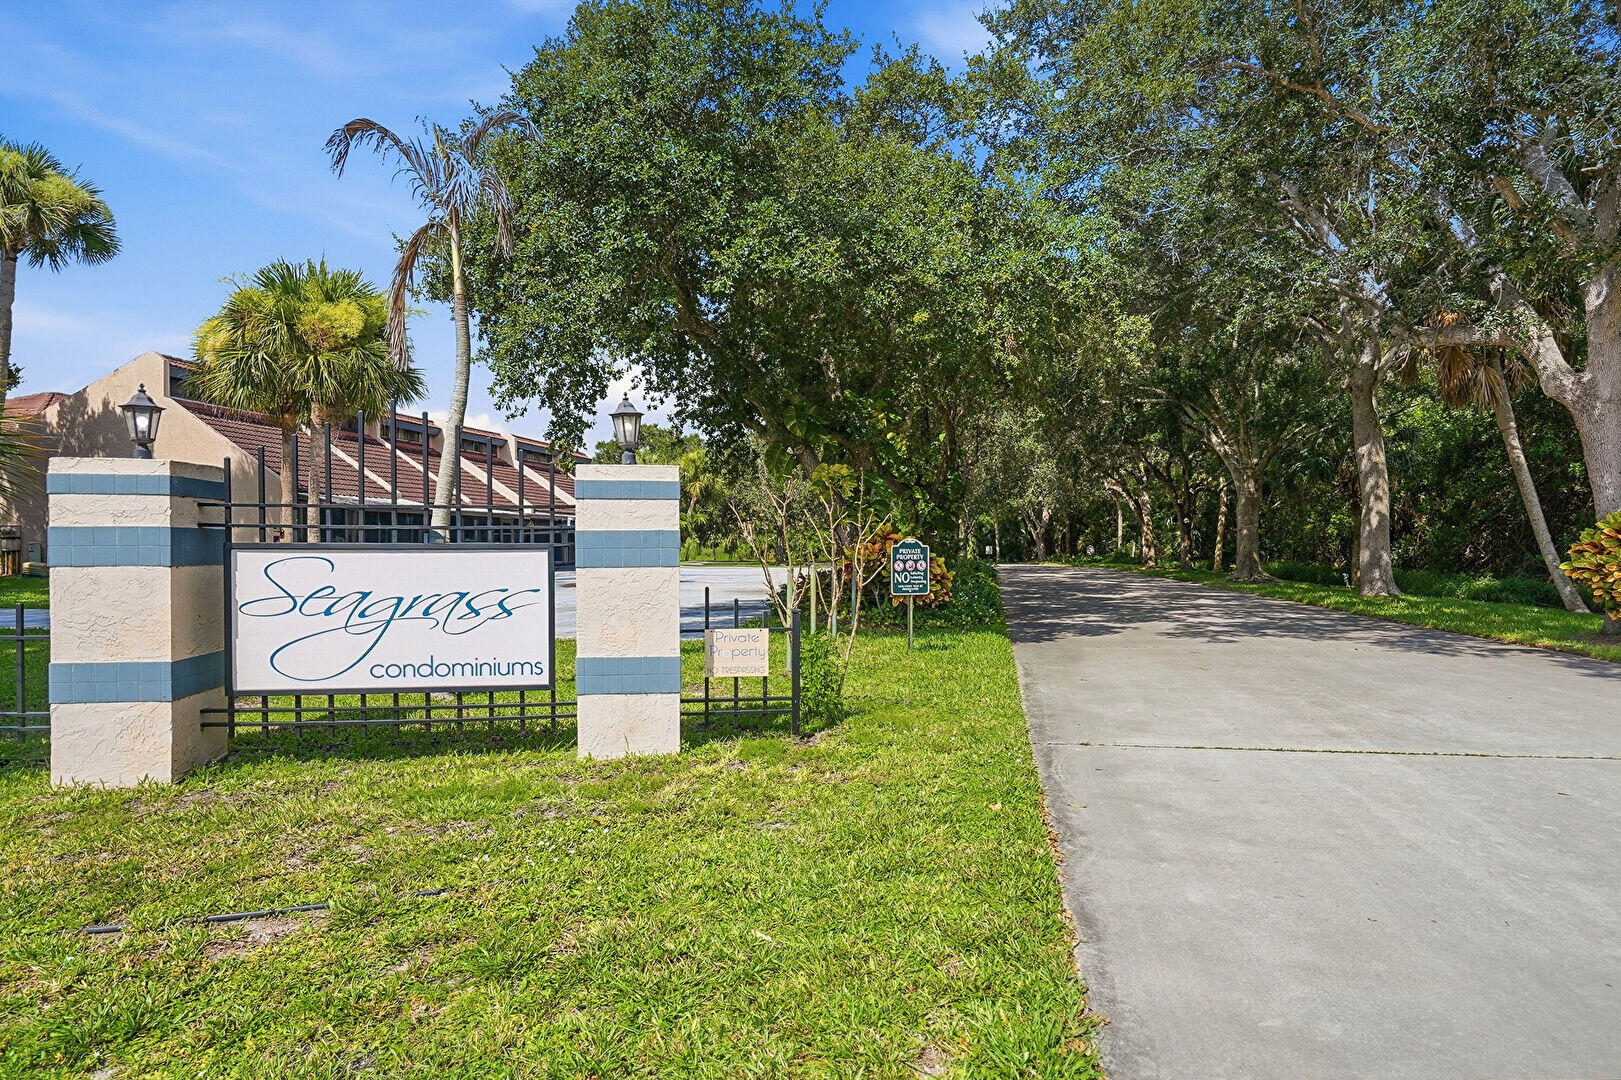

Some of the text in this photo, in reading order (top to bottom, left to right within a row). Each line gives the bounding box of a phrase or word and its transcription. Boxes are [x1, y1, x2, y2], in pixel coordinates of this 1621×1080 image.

[894, 572, 910, 584] NO
[239, 556, 540, 681] Seagrass
[715, 631, 760, 643] Private
[370, 655, 544, 679] condominiums
[721, 666, 766, 674] TRESPASSING
